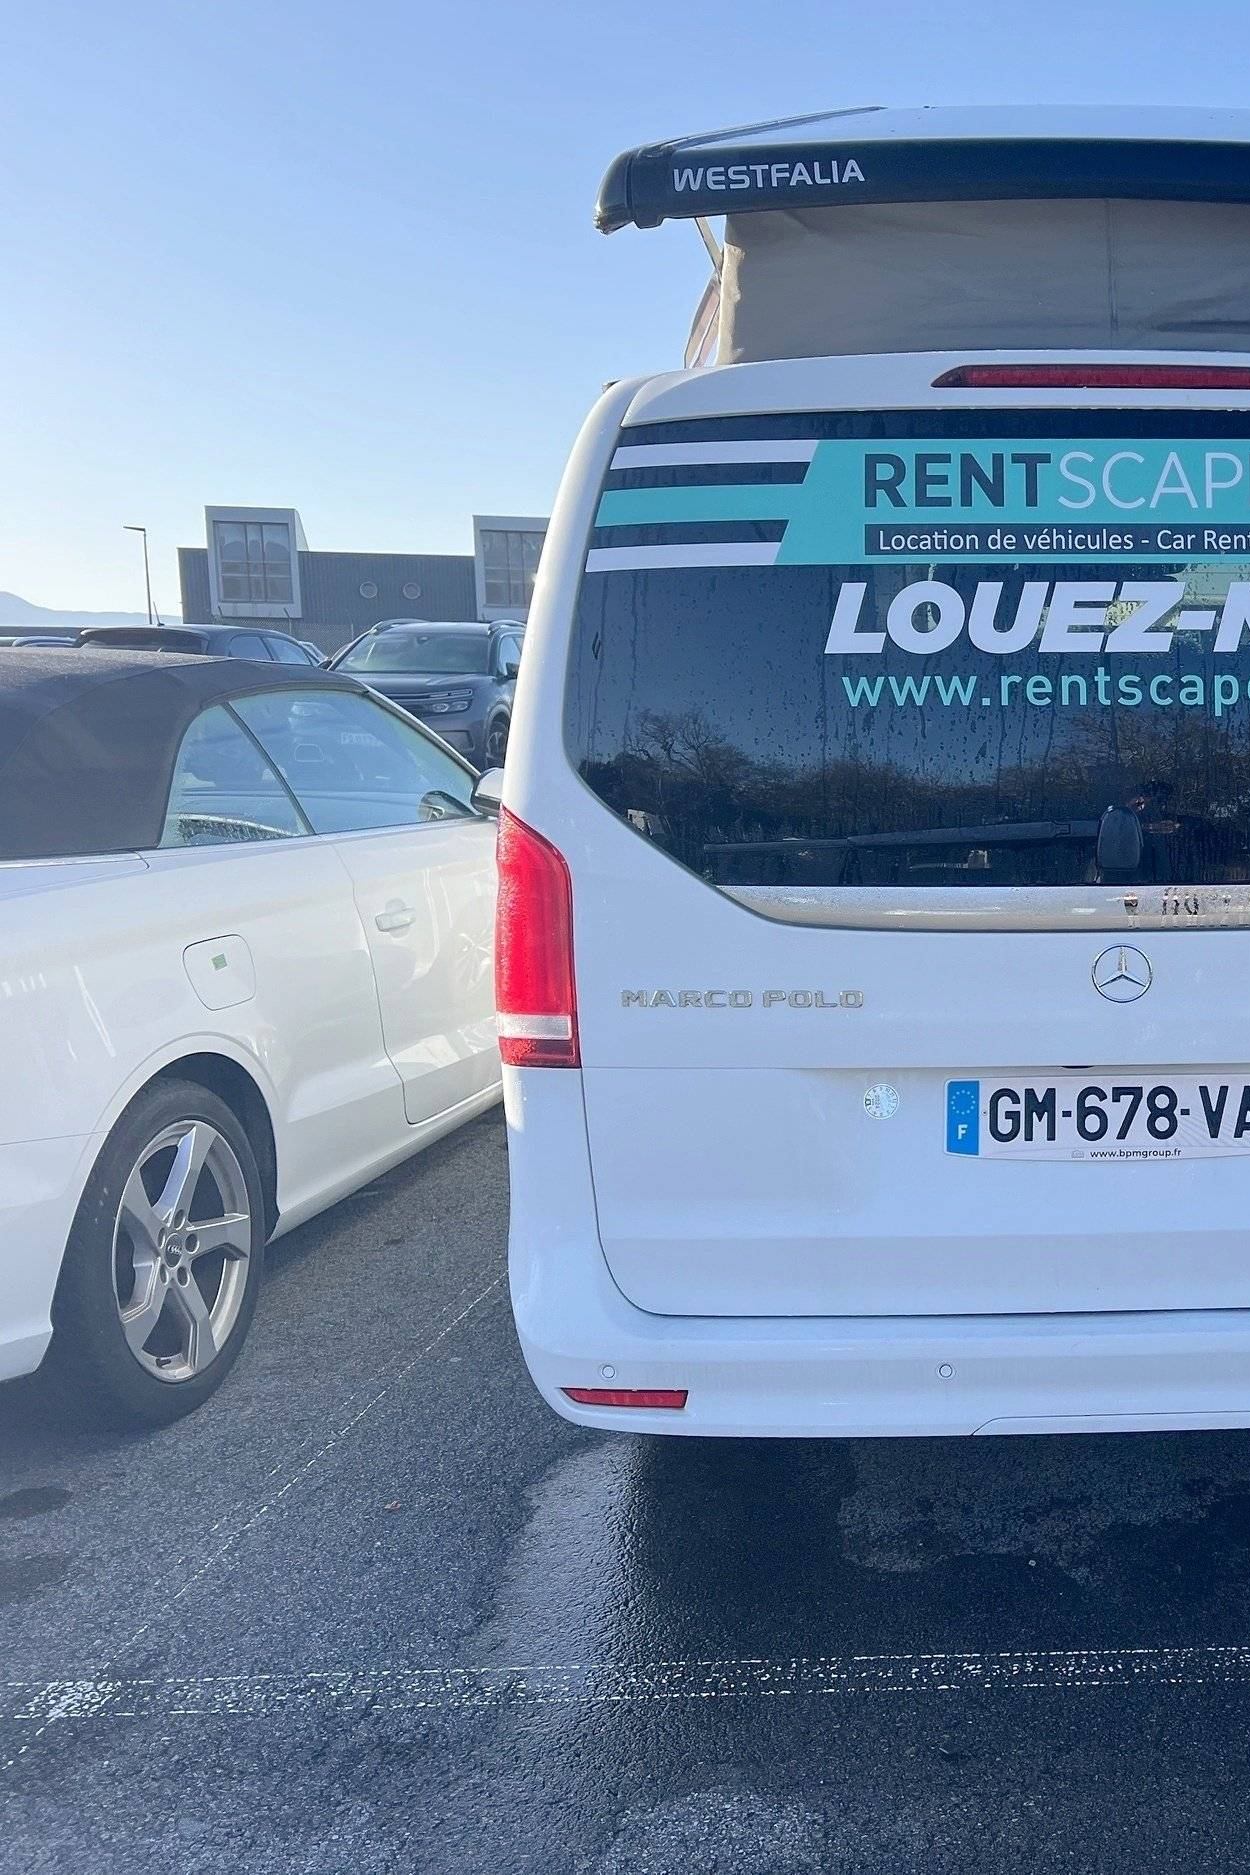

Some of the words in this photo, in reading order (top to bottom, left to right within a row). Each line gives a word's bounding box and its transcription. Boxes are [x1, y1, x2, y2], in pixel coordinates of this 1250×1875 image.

[673, 159, 865, 192] WESTFALIA
[879, 528, 979, 550] Location
[987, 528, 1016, 550] de
[1024, 528, 1134, 550] véhicules
[1157, 530, 1195, 550] Car
[620, 989, 752, 1008] MARCO
[762, 989, 865, 1008] POLO
[957, 1124, 968, 1140] F
[1090, 1148, 1182, 1158] www.bpmgroup.fr
